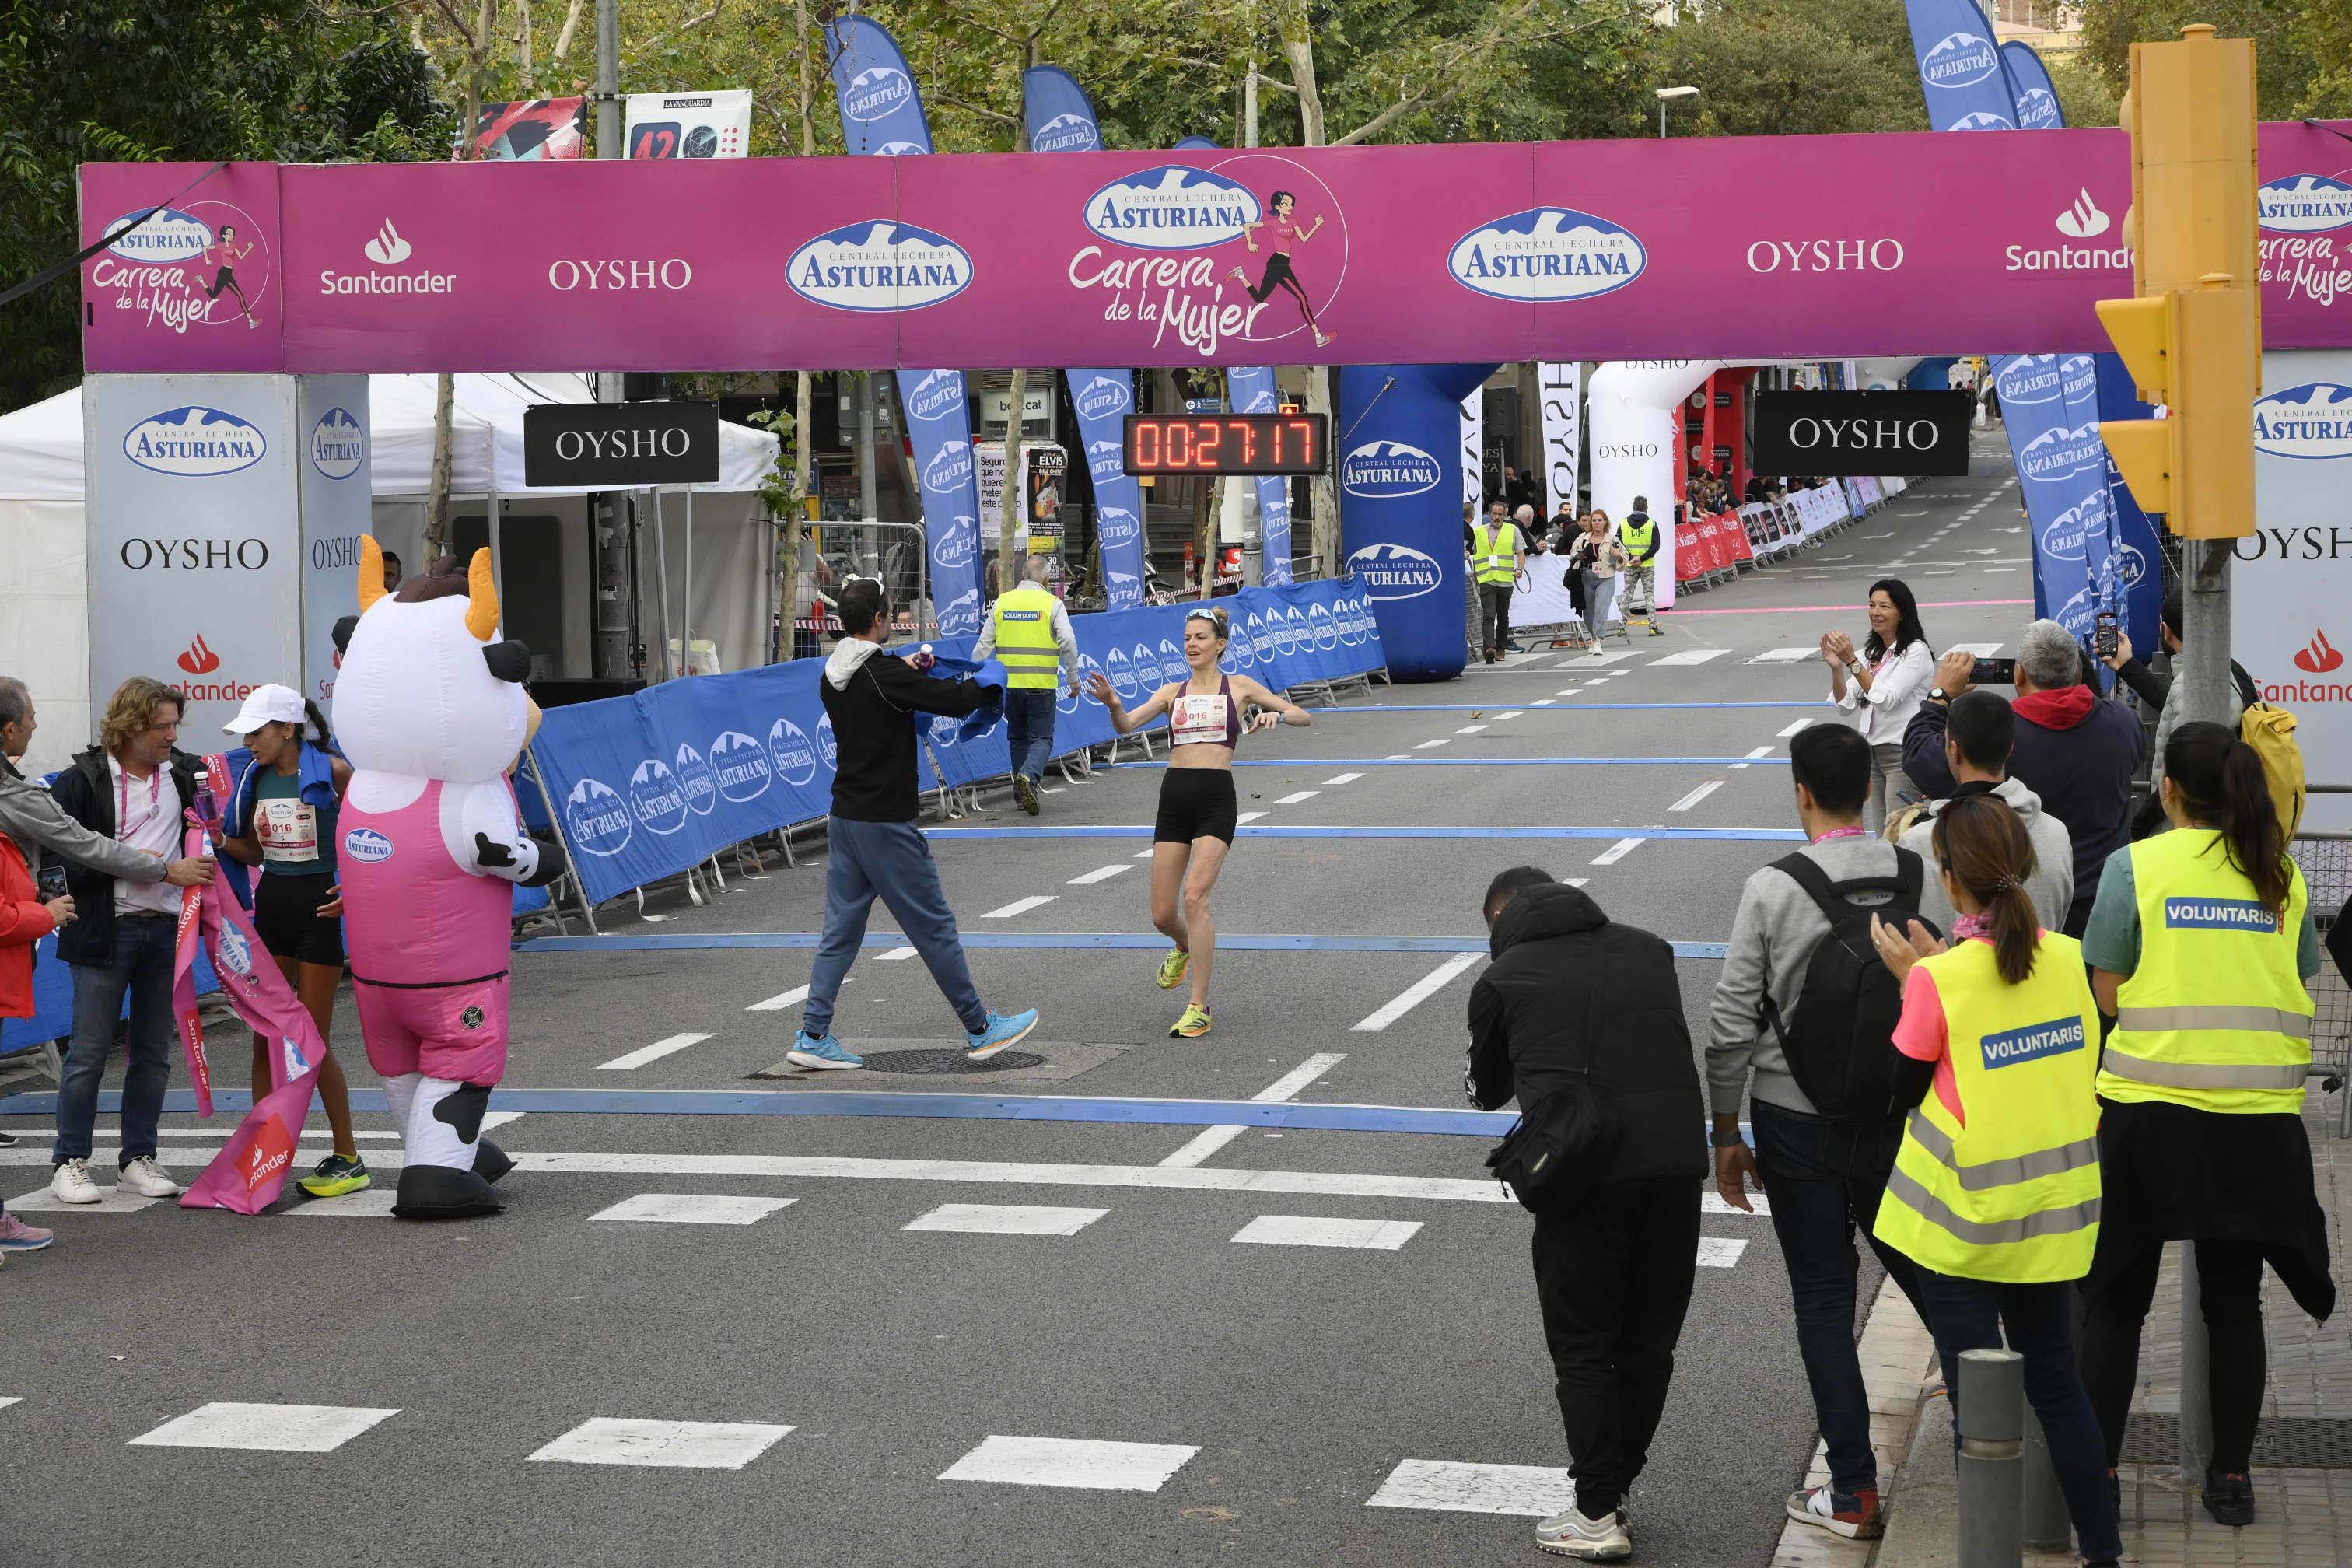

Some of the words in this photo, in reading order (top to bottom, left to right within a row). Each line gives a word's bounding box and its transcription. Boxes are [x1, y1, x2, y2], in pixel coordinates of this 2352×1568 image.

[1125, 194, 1180, 202] CENTRAL
[1185, 194, 1242, 202] LECHERA
[1097, 198, 1246, 229] ASTURIANA
[111, 226, 205, 248] ASTURIANA
[1493, 240, 1555, 250] CENTRAL
[1561, 238, 1625, 249] LECHERA
[2259, 237, 2333, 259] arrera
[829, 252, 887, 261] CENTRAL
[894, 250, 954, 260] LECHERA
[1069, 245, 1214, 289] Carrera
[1464, 243, 1631, 278] ASTURIANA
[1747, 238, 1904, 273] OYSHO
[2005, 244, 2135, 271] Santand
[93, 259, 185, 289] Carrera
[320, 269, 457, 295] Santander
[548, 259, 691, 290] OYSHO
[800, 254, 960, 288] ASTURIANA
[2277, 261, 2291, 282] la
[116, 289, 133, 309] de
[136, 289, 149, 309] la
[146, 285, 219, 334] Mujer
[1104, 291, 1132, 322] de
[1137, 289, 1157, 321] la
[1153, 283, 1269, 357] Mujer
[134, 432, 257, 459] ASTURIANA
[555, 427, 691, 460] OYSHO
[1136, 422, 1311, 466] 00:27:17
[1789, 418, 1939, 450] OYSHO
[315, 433, 361, 462] ASTURIANA
[1039, 456, 1063, 465] ELVIS
[1598, 443, 1657, 459] OYSHO
[981, 469, 994, 478] que
[1346, 464, 1433, 485] ASTURIANA
[1630, 528, 1645, 537] Life
[121, 538, 268, 570] OYSHO
[1048, 556, 1057, 565] 30
[1350, 566, 1434, 586] TURIANA
[1003, 611, 1038, 620] VOLUNTARIS
[1188, 712, 1207, 720] 016
[776, 747, 814, 771] ASTURIANA
[715, 758, 768, 789] ASTURIANA
[272, 823, 292, 833] 016
[346, 841, 389, 856] ASTURIANA
[2168, 903, 2274, 926] VOLUNTARIS
[187, 1018, 208, 1090] Santander
[1984, 1024, 2084, 1061] VOLUNTARIS
